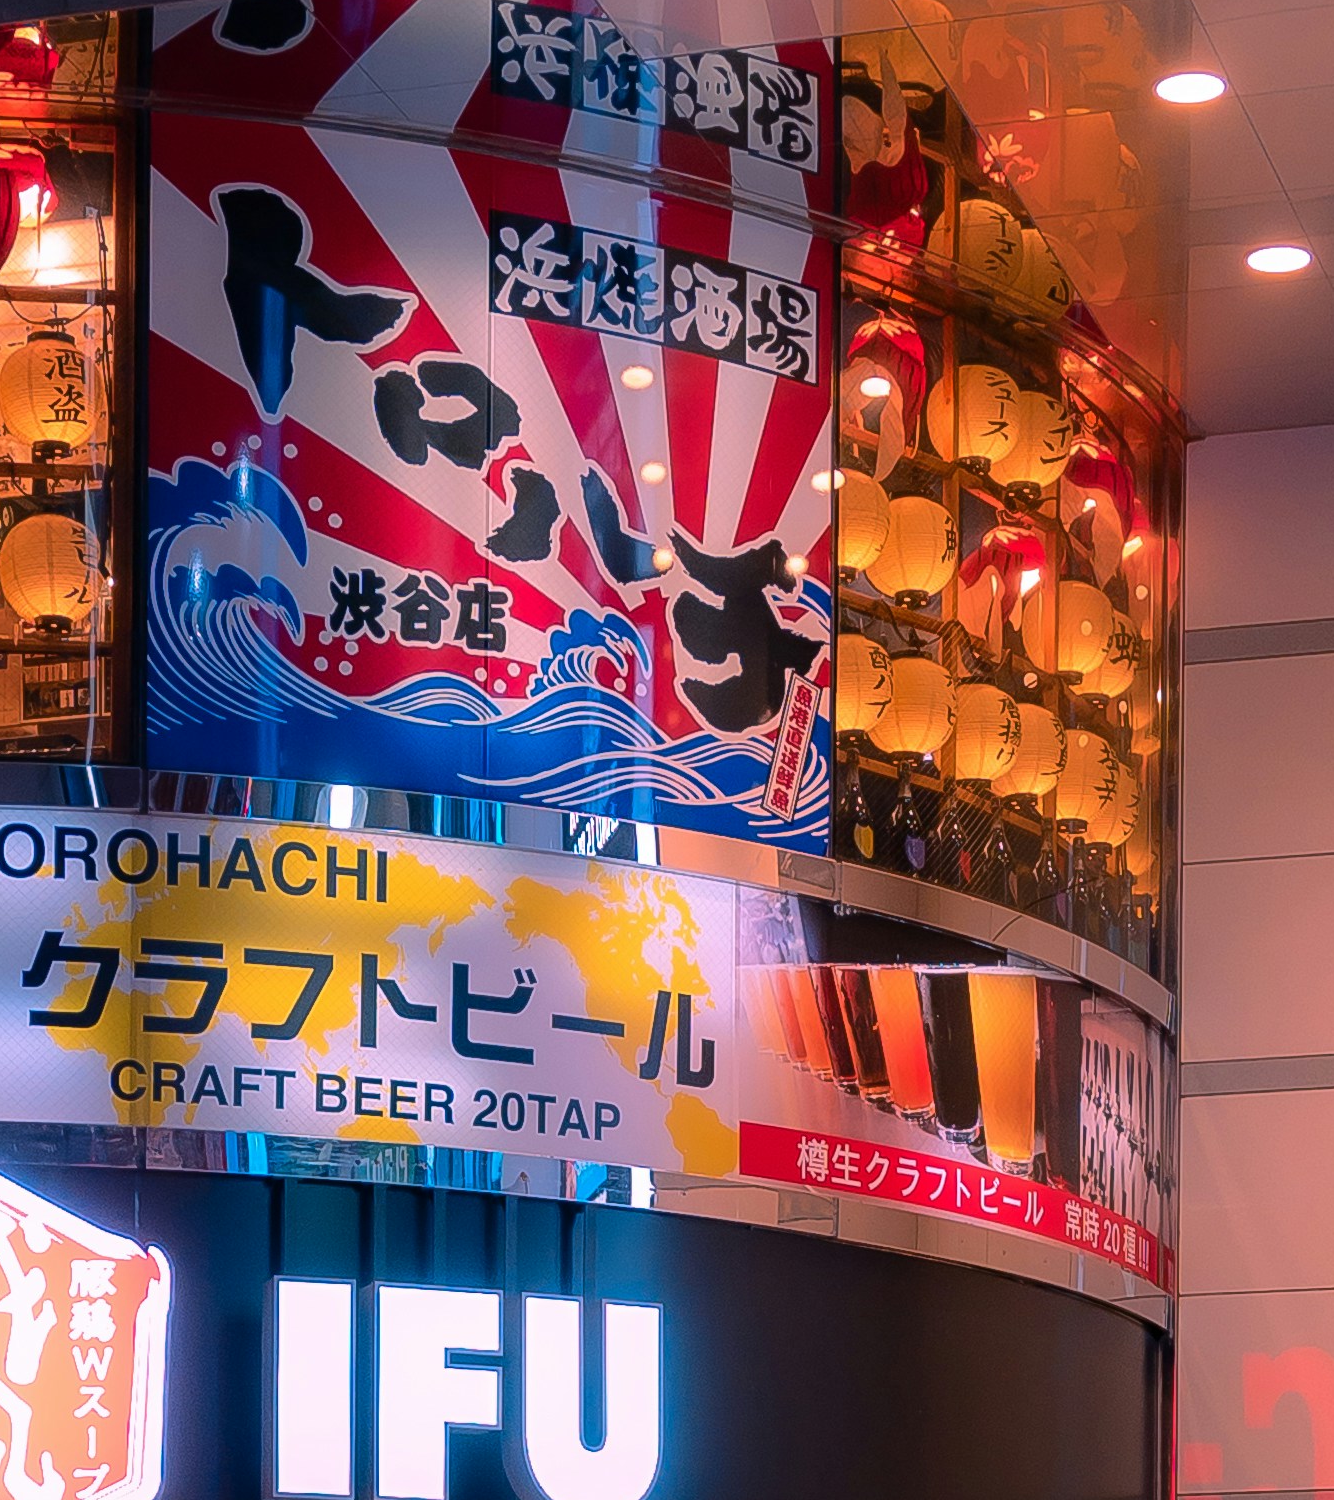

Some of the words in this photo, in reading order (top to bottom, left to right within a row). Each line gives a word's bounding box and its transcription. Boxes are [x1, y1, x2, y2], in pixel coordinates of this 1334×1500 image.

[491, 211, 821, 388] 浜焼酒場
[983, 369, 1017, 442] ジュース
[213, 183, 832, 742] トロハチ
[328, 562, 516, 656] 渋谷店
[21, 928, 716, 1090] クラフトビール
[109, 1059, 298, 1111] CRAFT
[314, 1073, 456, 1126] BEER
[471, 1089, 622, 1143] 20TAP
[796, 1134, 1045, 1228] 樽生クラフトビール
